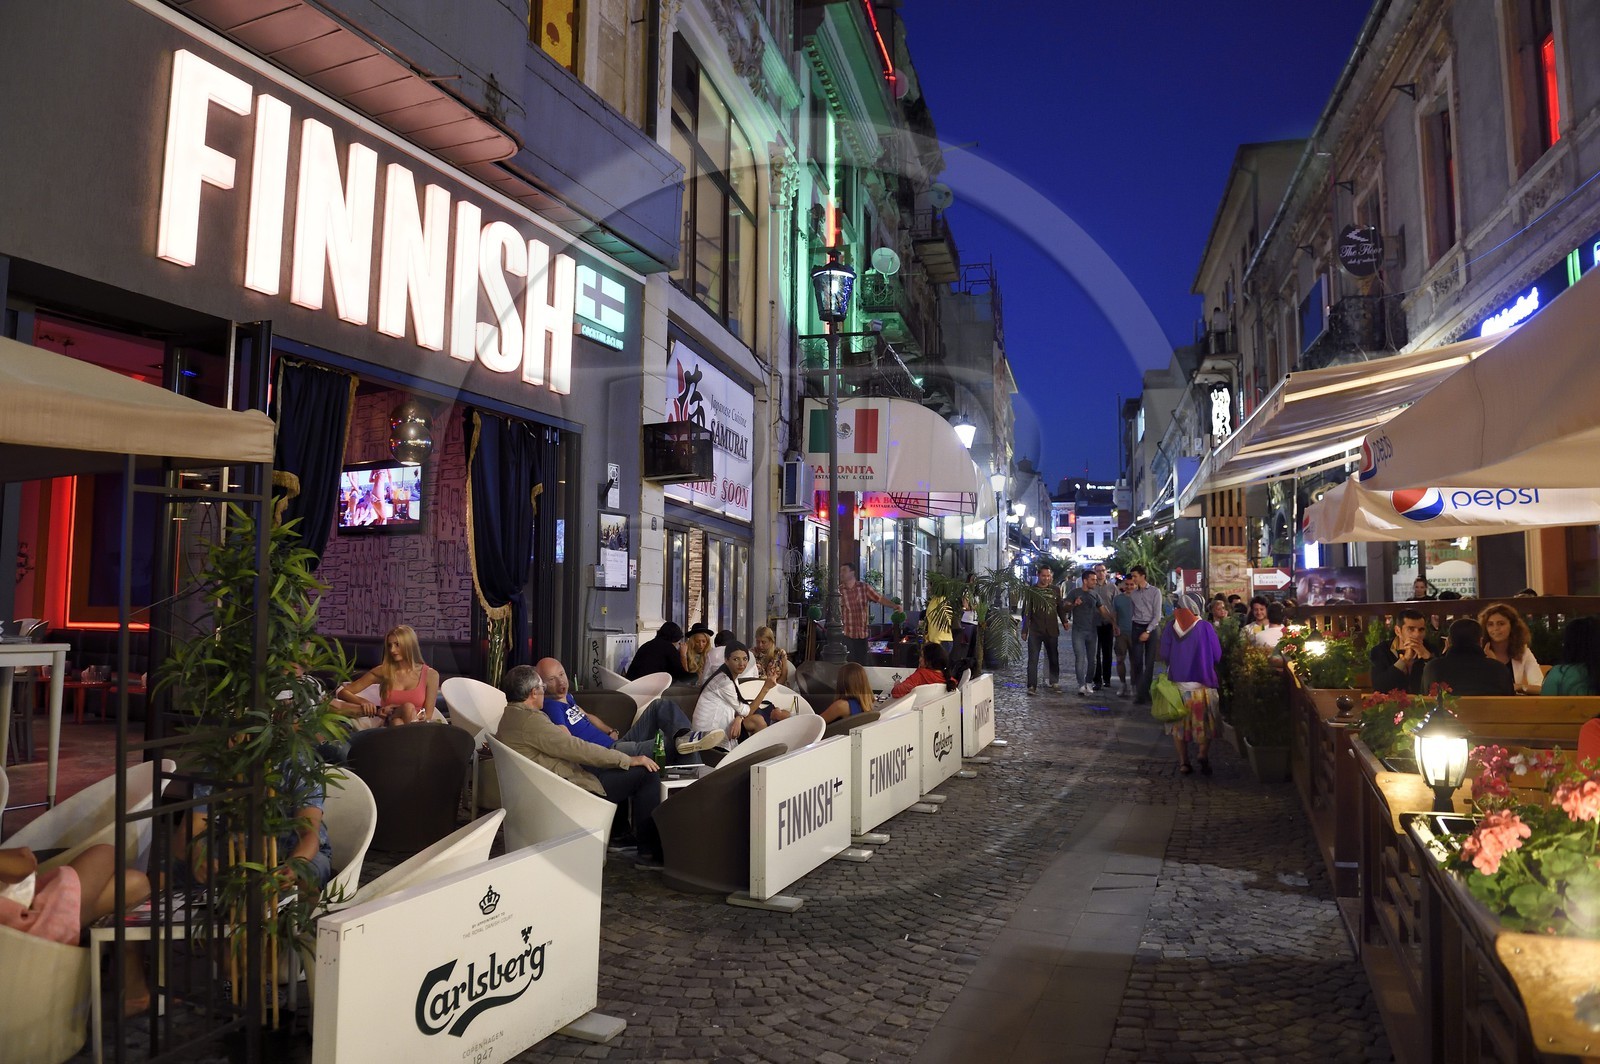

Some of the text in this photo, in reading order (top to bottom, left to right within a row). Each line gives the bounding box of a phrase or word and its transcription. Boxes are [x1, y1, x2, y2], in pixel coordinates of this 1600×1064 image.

[157, 49, 576, 395] FINNISH
[710, 394, 747, 428] Japanese Cuisine
[710, 418, 748, 460] SAMURAI
[827, 465, 875, 474] ONITA
[721, 479, 749, 509] SOON
[1451, 487, 1540, 511] pepsi
[869, 744, 907, 798] FINNISH
[778, 778, 833, 851] FINNISH
[472, 927, 484, 936] ROYAL
[485, 920, 500, 931] DANISH
[500, 913, 514, 924] COURT
[415, 942, 547, 1037] Carlsberg
[462, 1030, 504, 1059] COPENHAGEN
[473, 1047, 494, 1064] 1847
